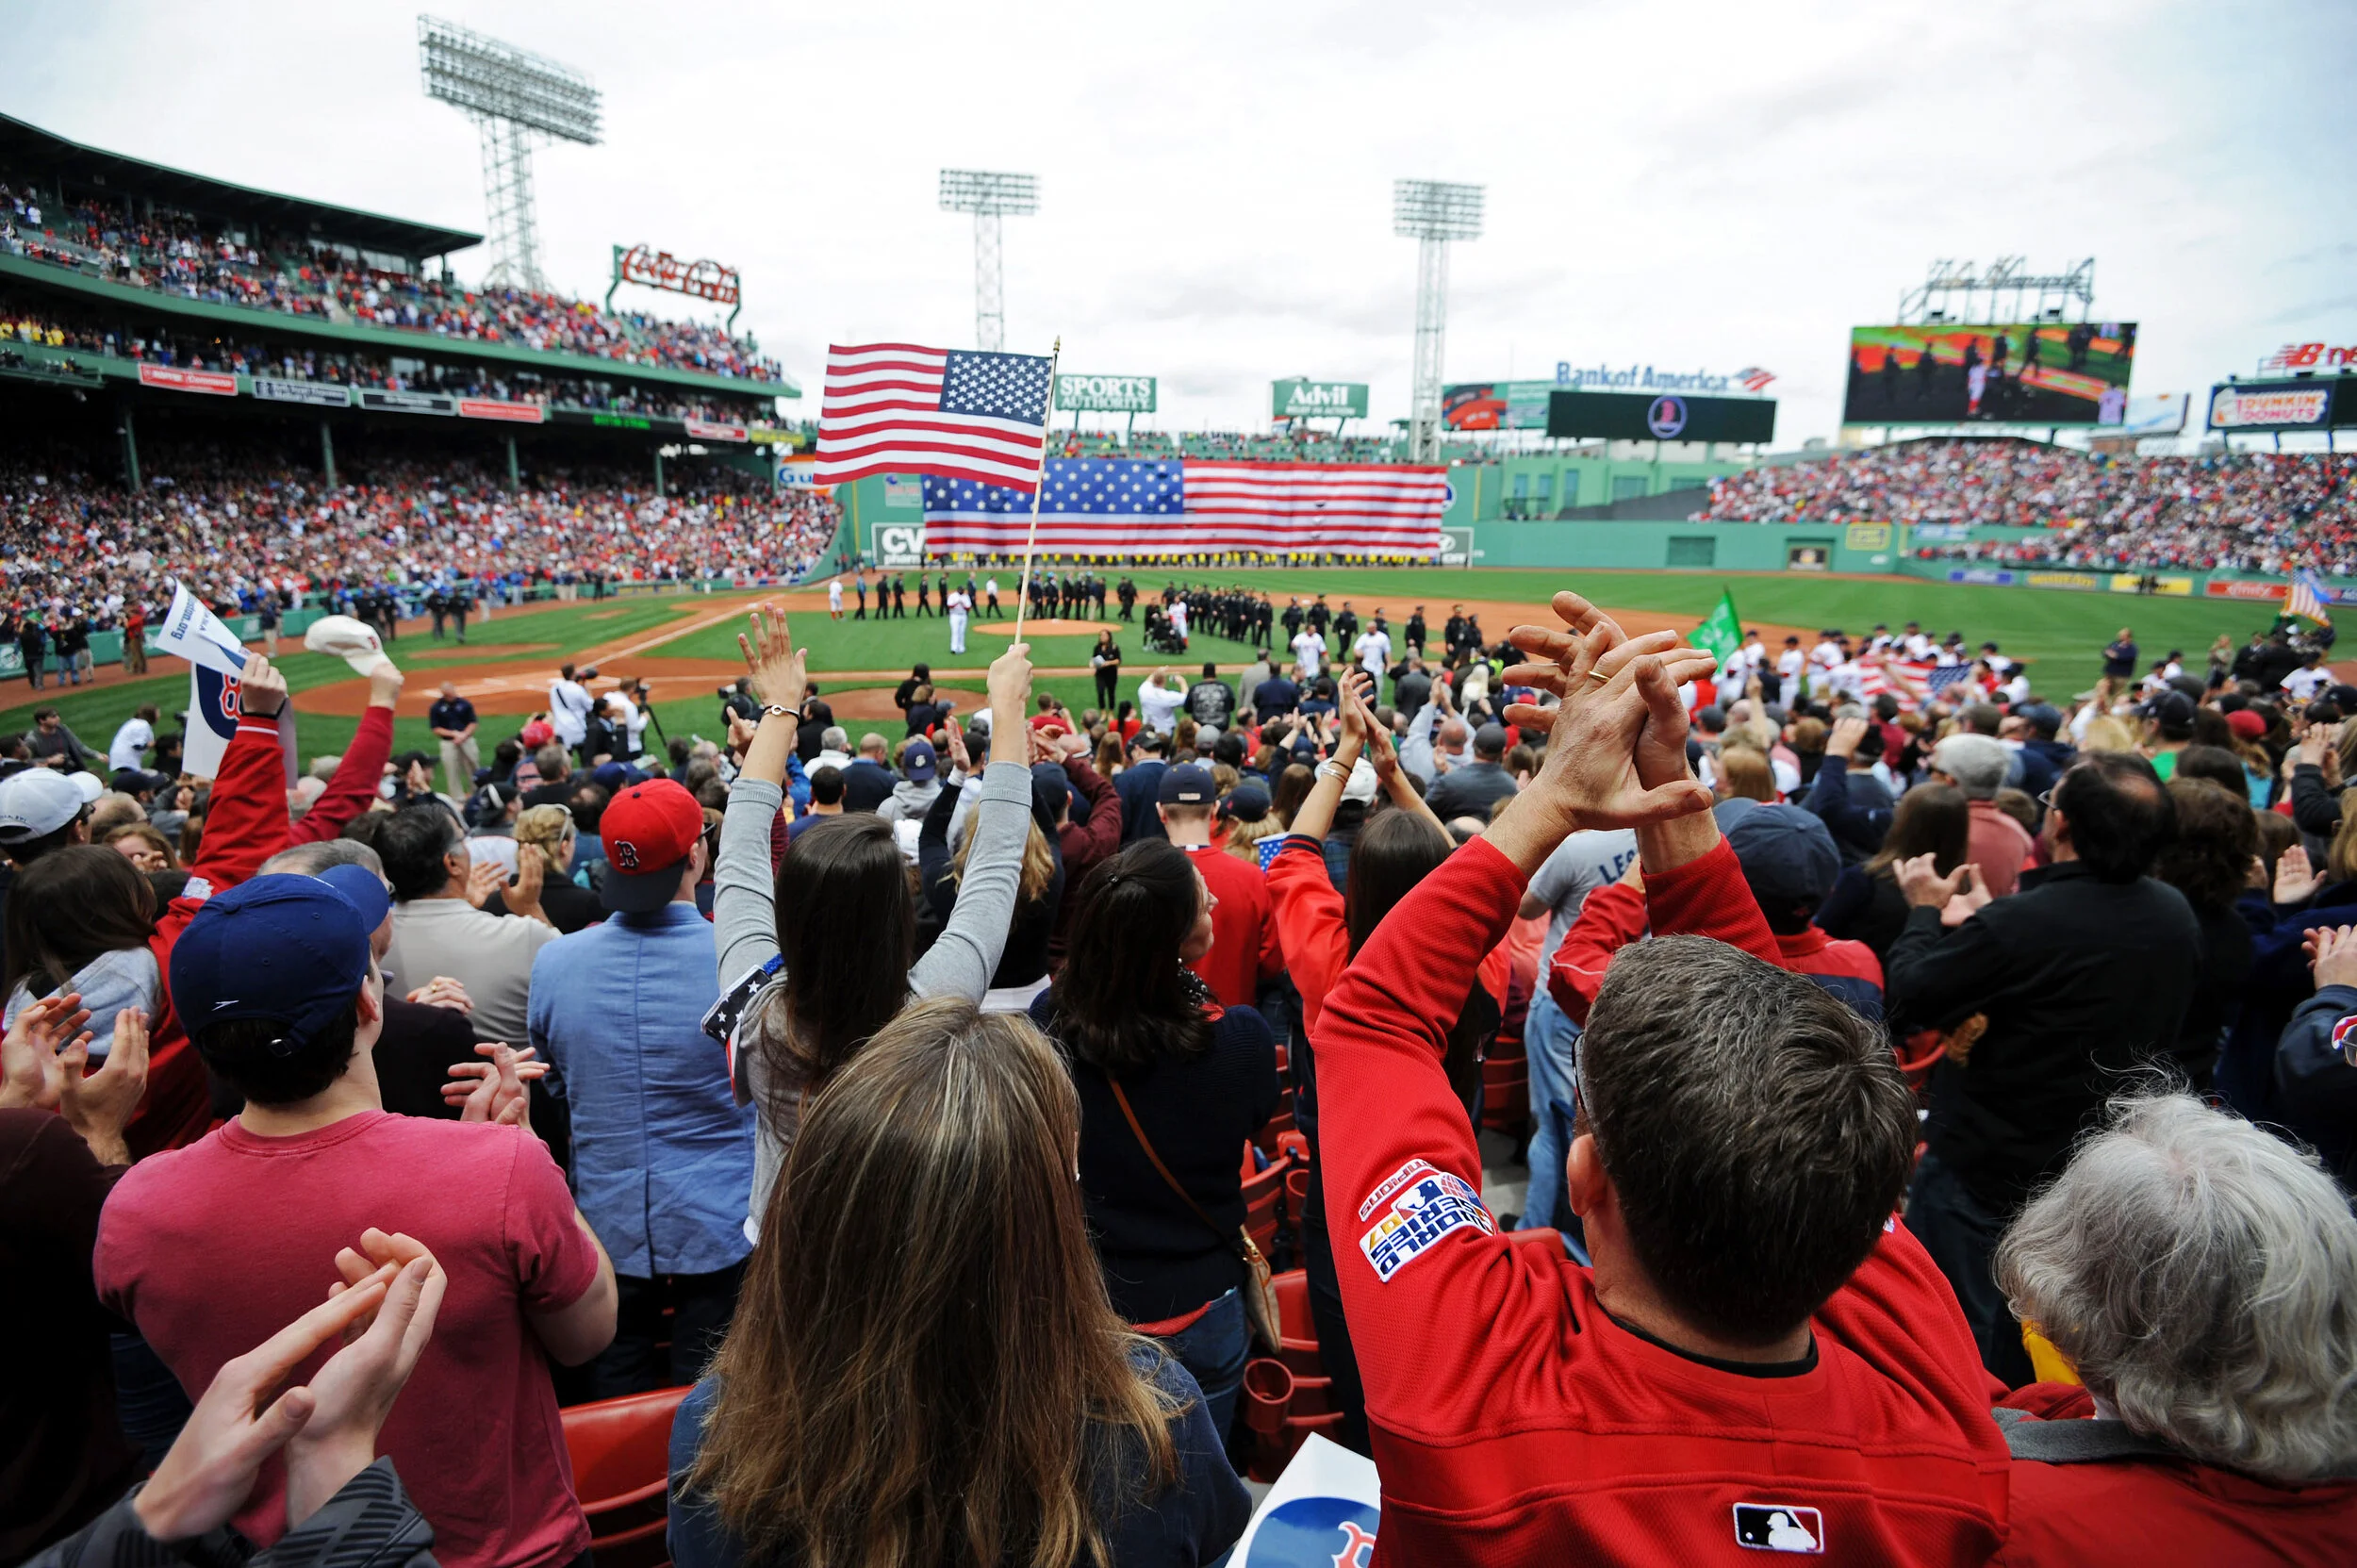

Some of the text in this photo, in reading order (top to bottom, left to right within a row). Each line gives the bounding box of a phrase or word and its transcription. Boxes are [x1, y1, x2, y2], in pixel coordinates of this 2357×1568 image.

[1060, 376, 1151, 398] SPORTS
[1557, 361, 1729, 391] Bank of America
[1061, 396, 1149, 410] AUTHORITY
[1287, 385, 1349, 405] Advil
[2244, 407, 2316, 421] DONUTS
[779, 467, 813, 483] Gu
[882, 527, 928, 556] CV
[1360, 1160, 1437, 1218] MPIONS
[1369, 1213, 1402, 1251] 07
[1370, 1196, 1479, 1264] SERIES
[1379, 1210, 1489, 1276] WORLD
